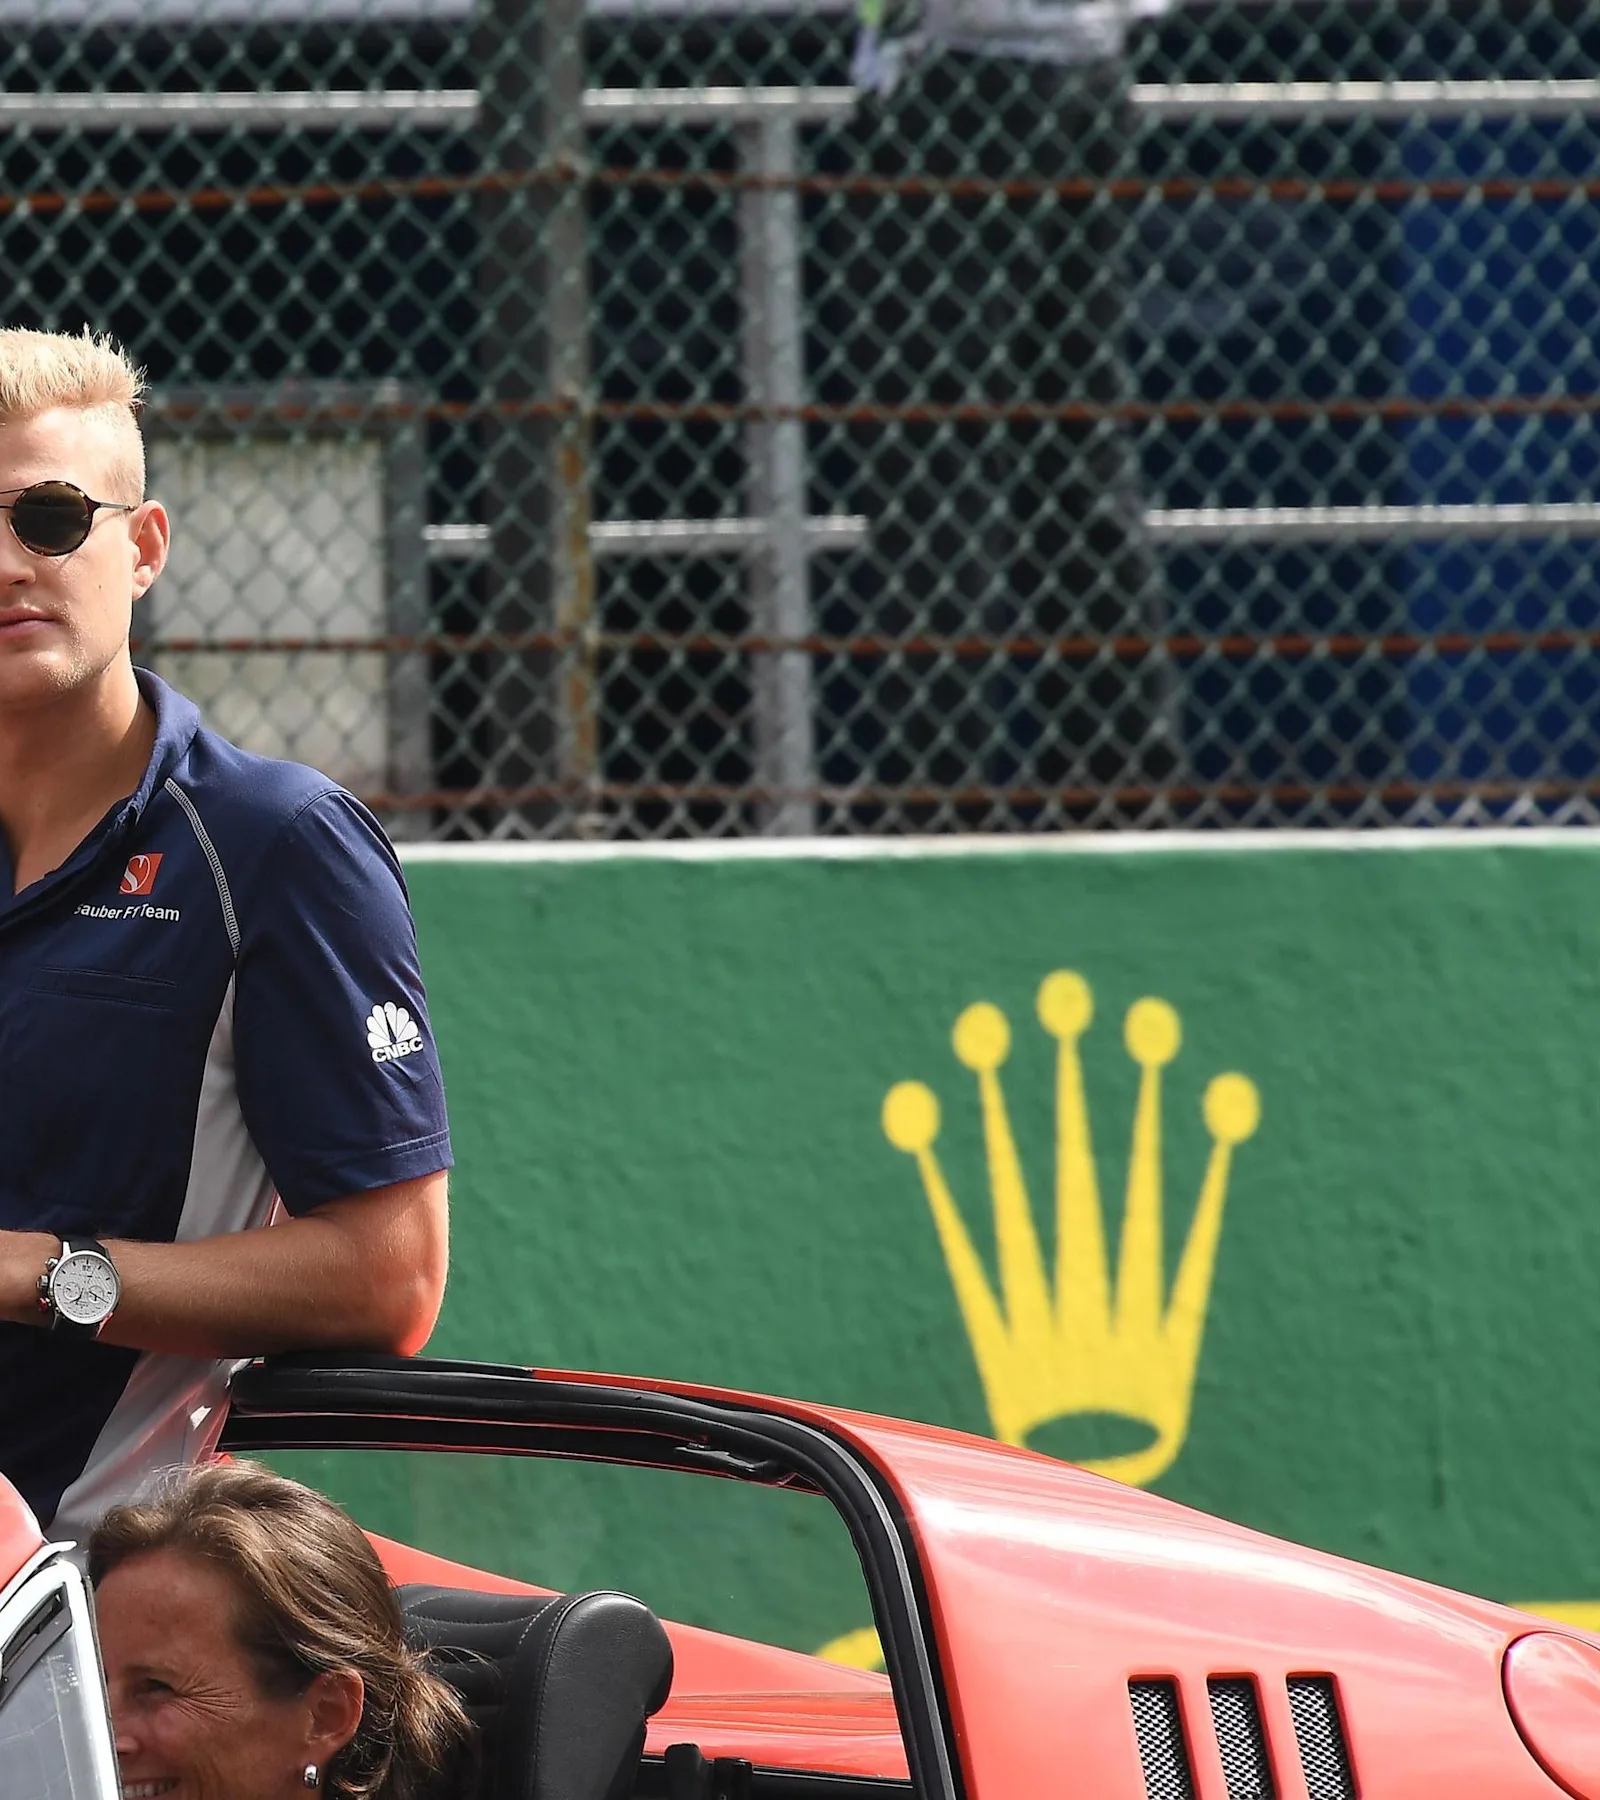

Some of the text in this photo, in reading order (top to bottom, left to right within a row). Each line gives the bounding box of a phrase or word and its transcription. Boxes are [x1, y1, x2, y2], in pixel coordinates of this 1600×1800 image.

[122, 906, 141, 919] F1
[140, 903, 180, 921] Team
[372, 1037, 424, 1063] CNBC
